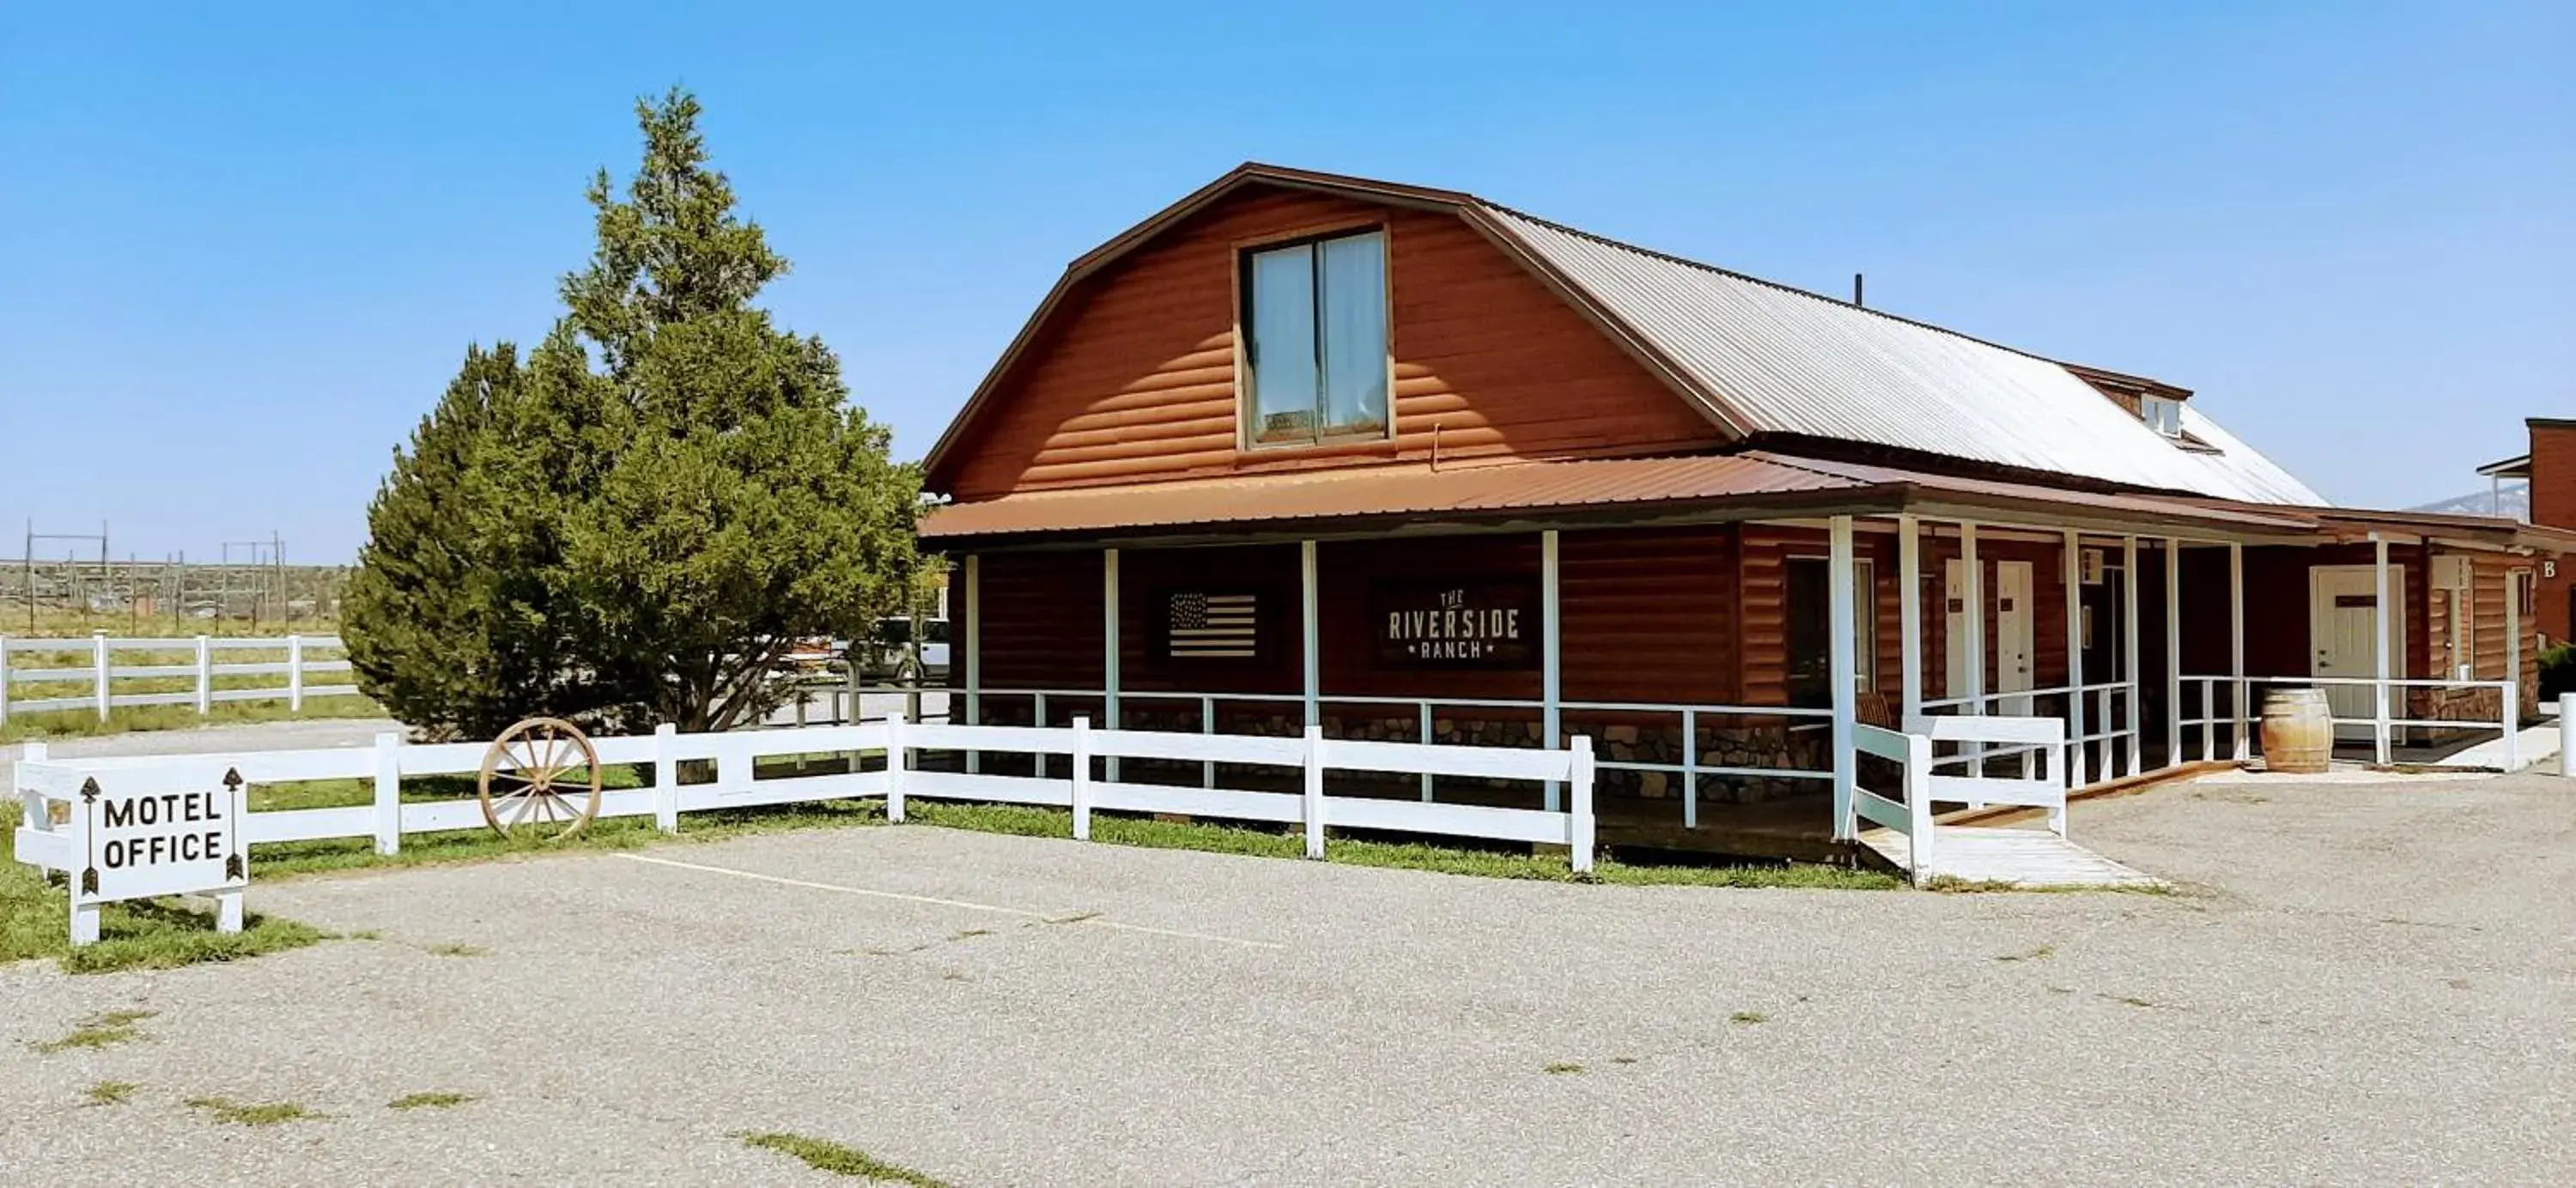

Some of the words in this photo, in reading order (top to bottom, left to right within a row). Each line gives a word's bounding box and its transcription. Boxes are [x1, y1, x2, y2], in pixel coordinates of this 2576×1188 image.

[2543, 561, 2555, 578] B
[1441, 589, 1464, 607] THE
[1389, 609, 1519, 639] RIVERSIDE
[1422, 641, 1480, 658] RANCH
[104, 791, 222, 827] MOTEL
[104, 832, 222, 869] OFFICE
